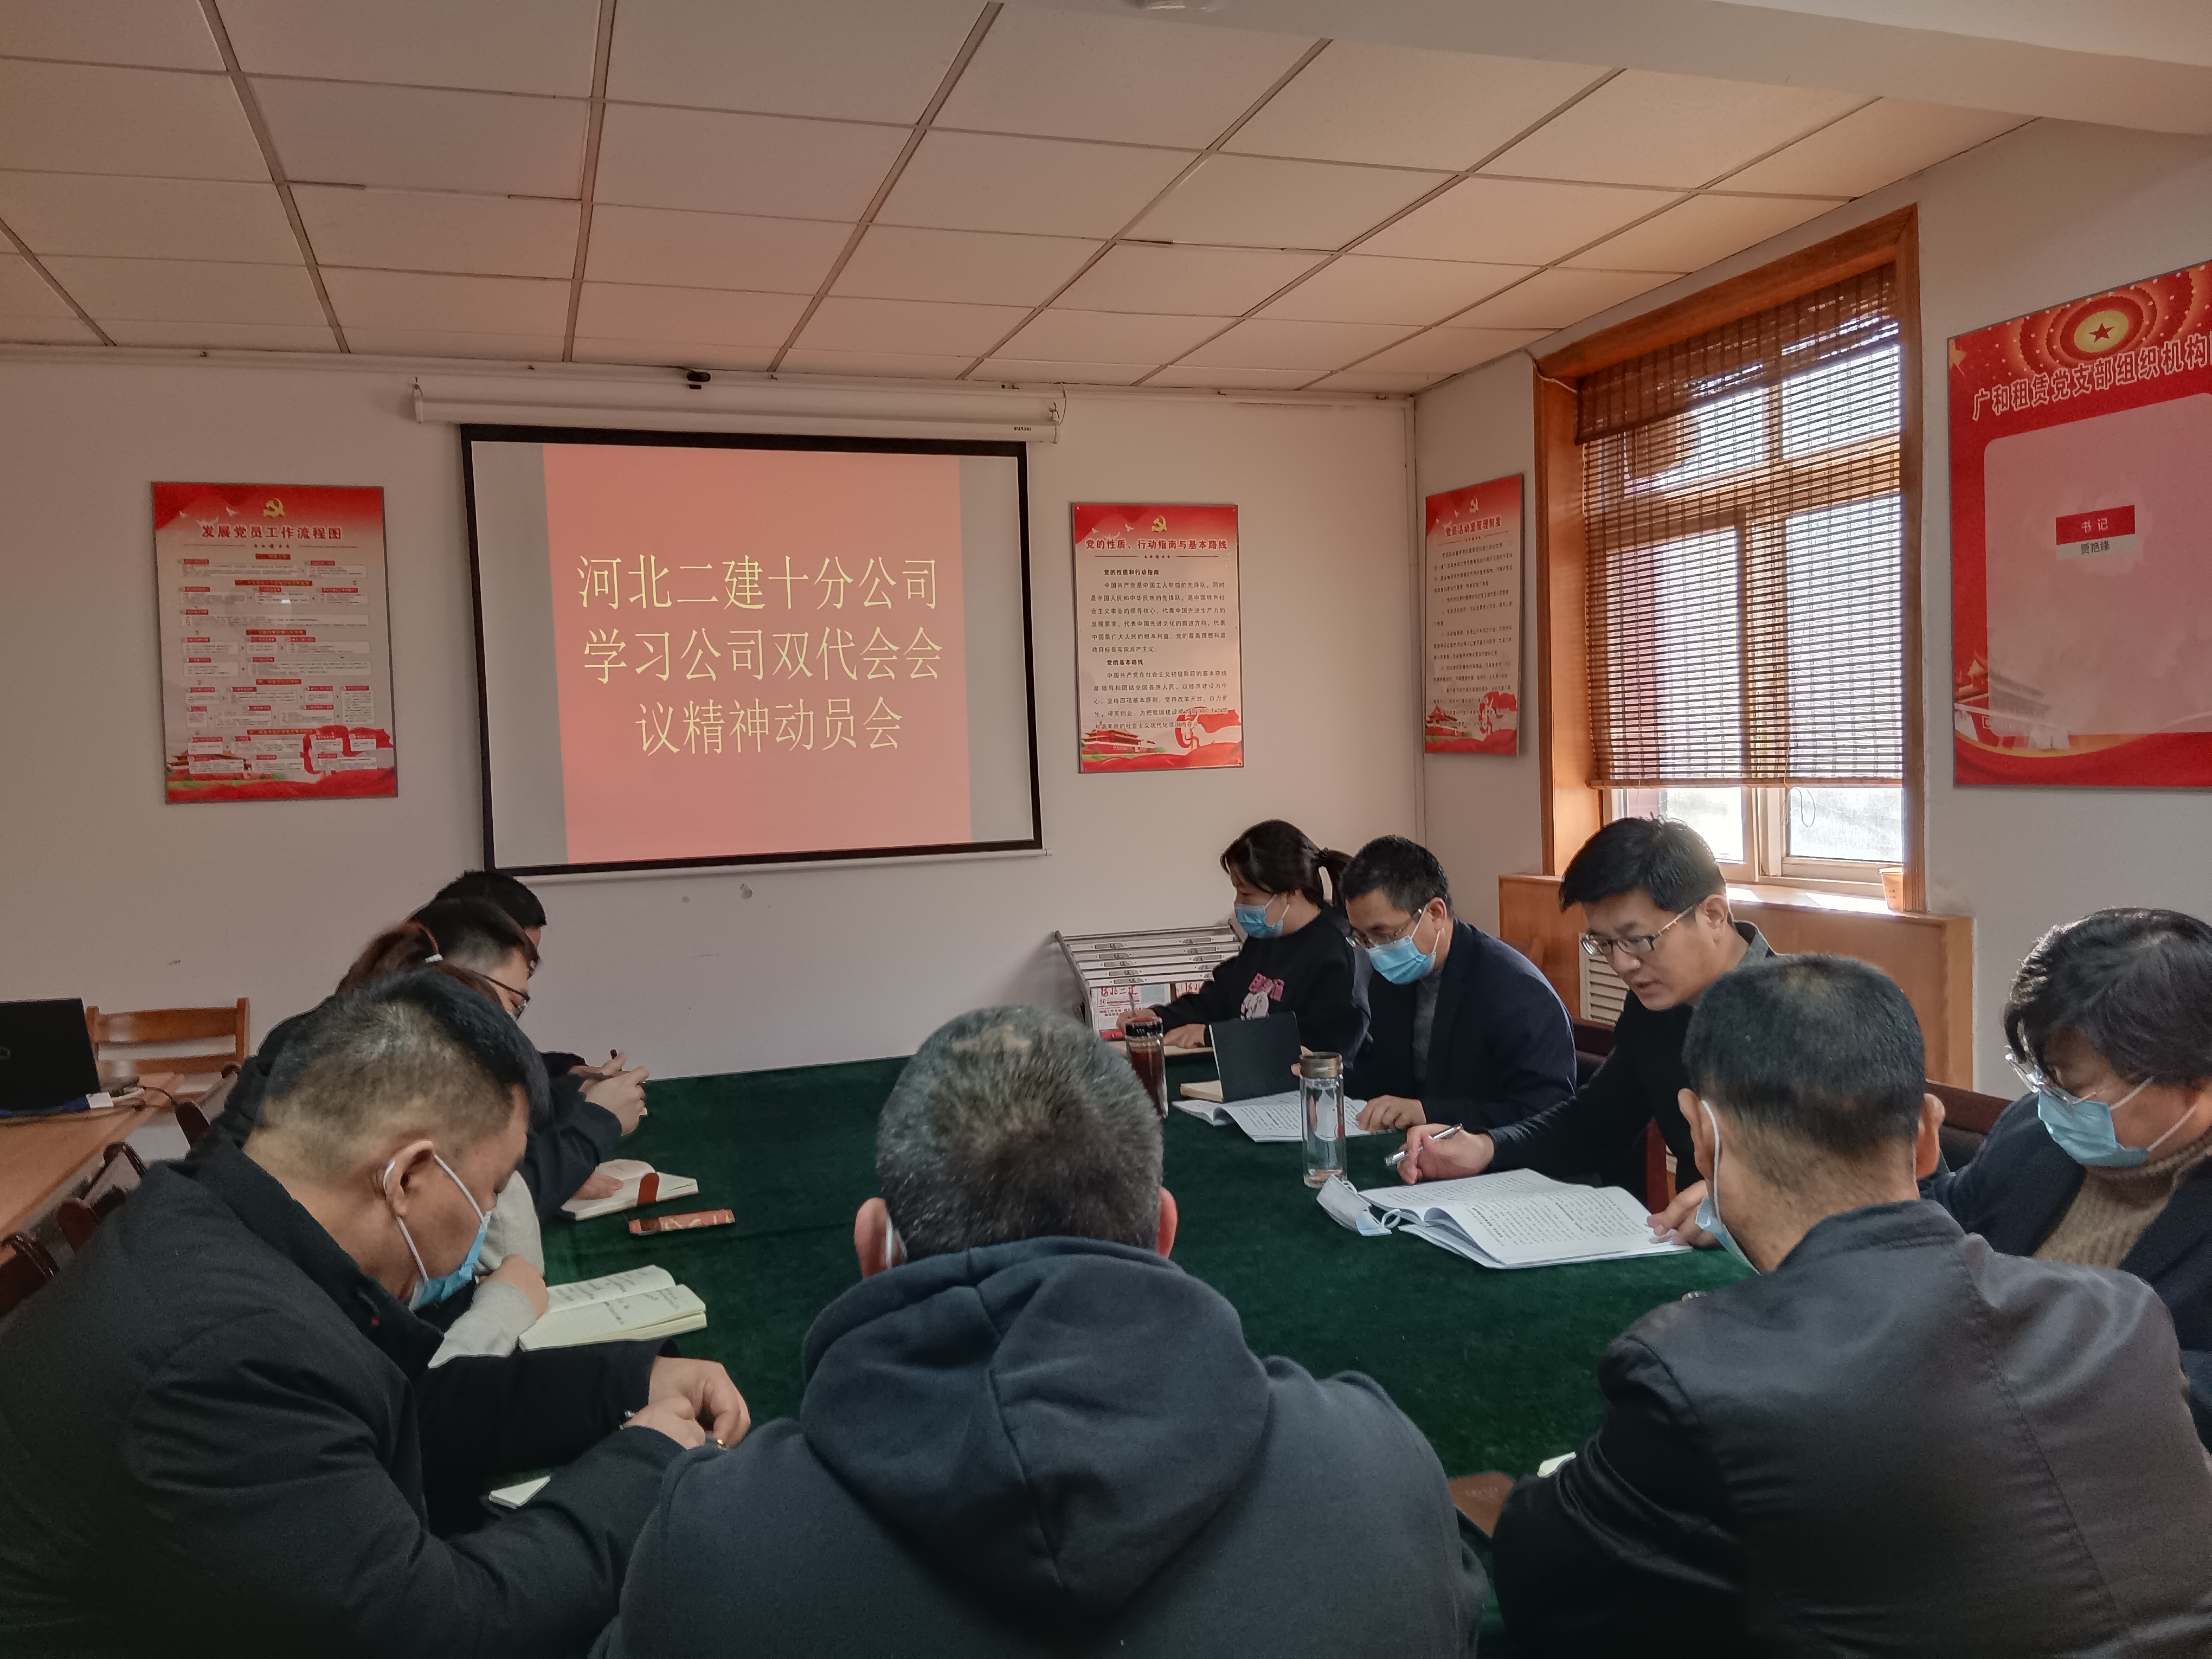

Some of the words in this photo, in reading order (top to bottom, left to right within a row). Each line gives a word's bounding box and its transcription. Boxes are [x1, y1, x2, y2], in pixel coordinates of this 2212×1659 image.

[1972, 332, 2212, 421] 广和租赁党支部组织机构
[202, 525, 342, 539] 发展党员工作流程图
[1085, 539, 1227, 550] 党的性质、行动指南与基本路线
[2081, 517, 2108, 534] 书记
[577, 554, 938, 610] 河北二建十分公司
[583, 626, 943, 684] 学习公司双代会会
[635, 696, 903, 756] 议精神动员会
